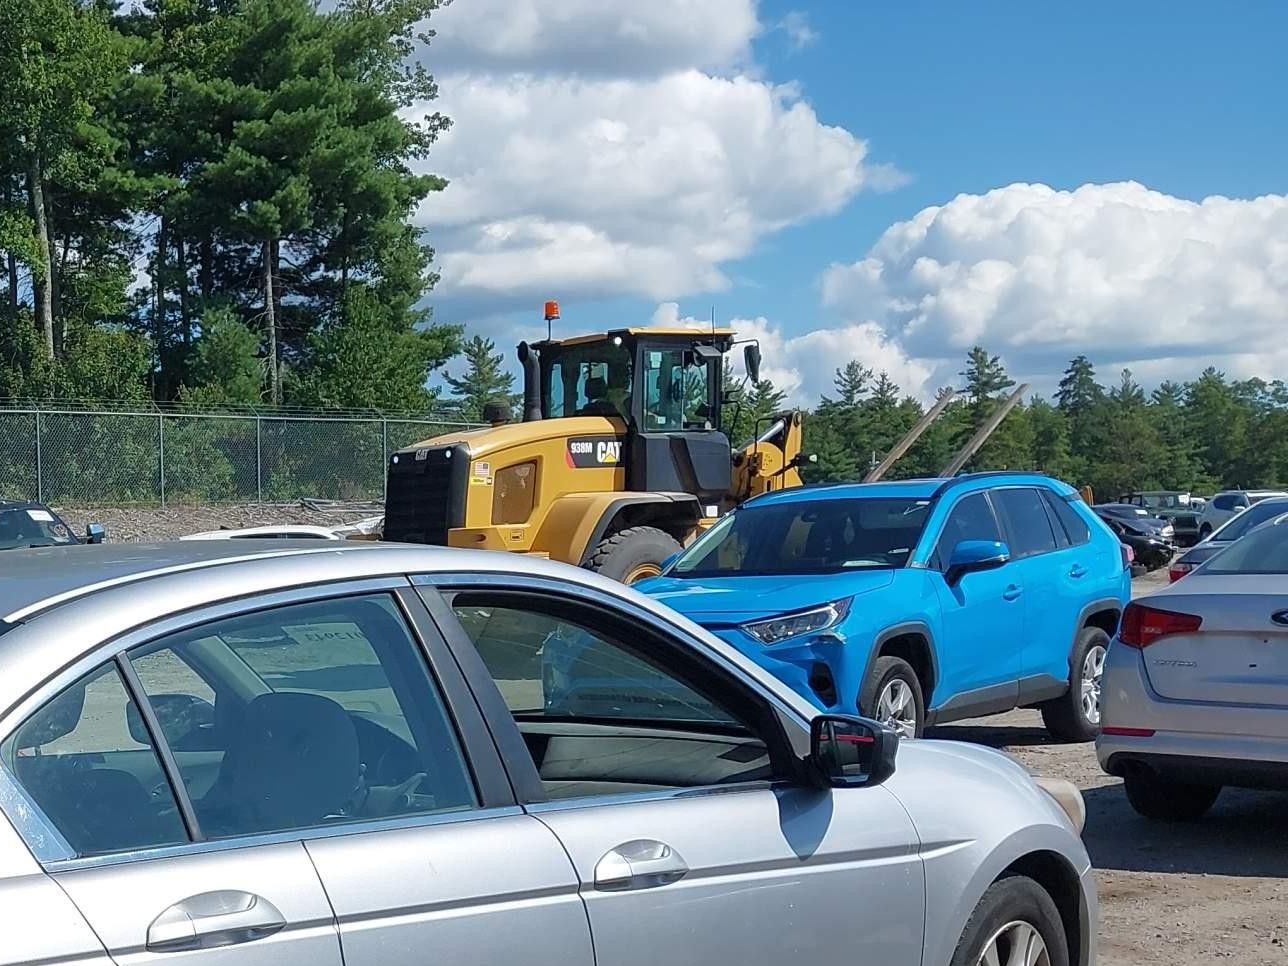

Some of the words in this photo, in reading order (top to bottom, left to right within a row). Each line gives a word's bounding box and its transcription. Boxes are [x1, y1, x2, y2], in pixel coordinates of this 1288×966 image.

[571, 442, 592, 453] 938M
[597, 441, 622, 463] CAT
[415, 449, 430, 461] CAT
